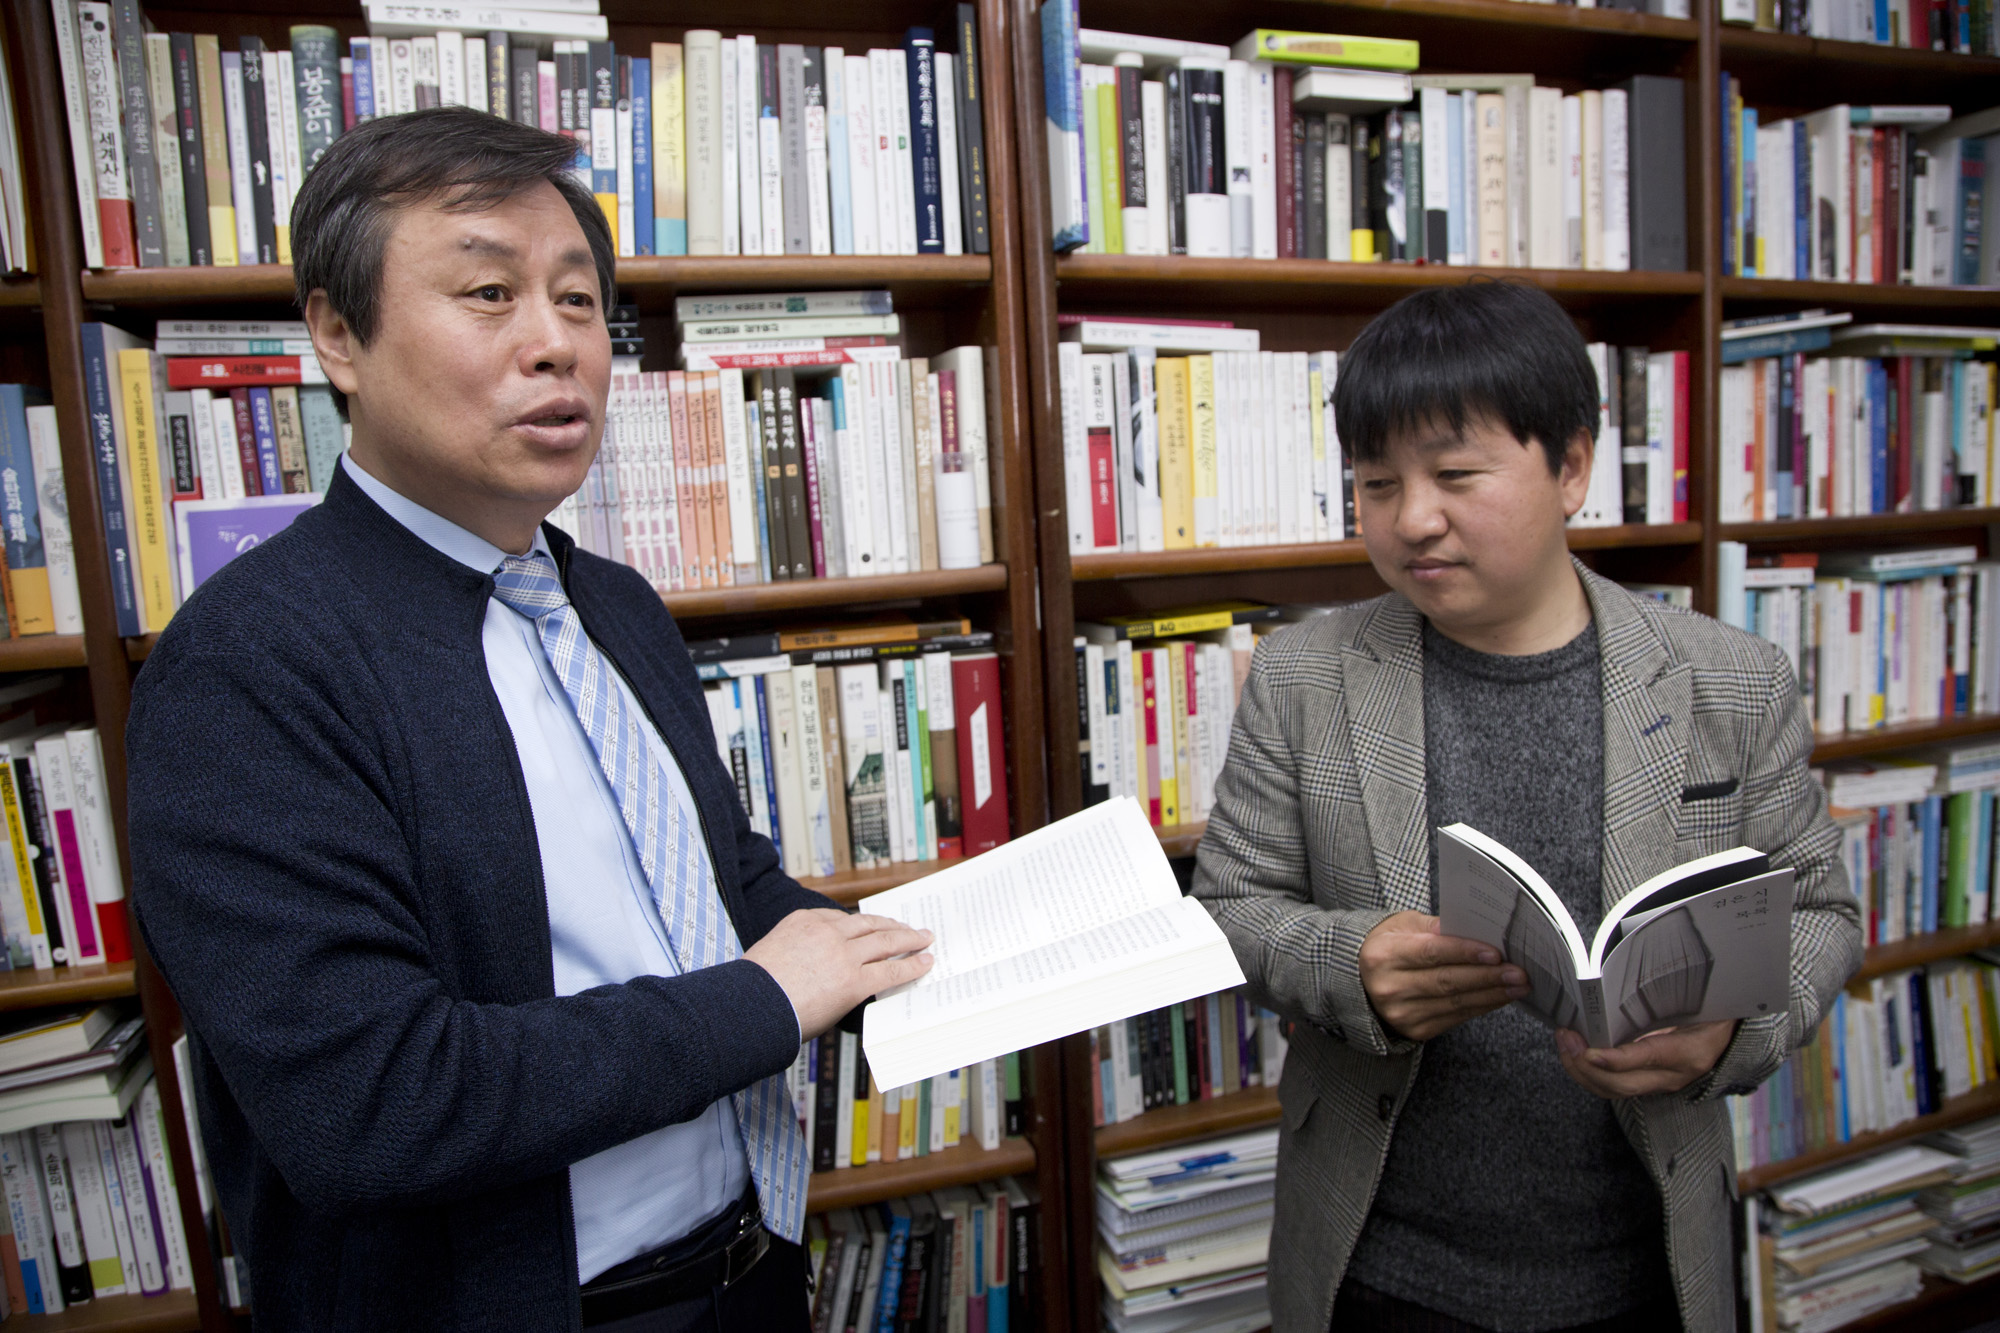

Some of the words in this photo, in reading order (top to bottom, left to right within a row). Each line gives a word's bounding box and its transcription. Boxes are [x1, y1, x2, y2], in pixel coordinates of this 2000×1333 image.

[299, 65, 336, 144] 봉준이,
[99, 131, 120, 177] 세계사
[200, 363, 229, 378] 도올,
[1199, 412, 1216, 473] Nudge
[1159, 621, 1175, 633] AQ
[53, 1190, 68, 1213] 시대
